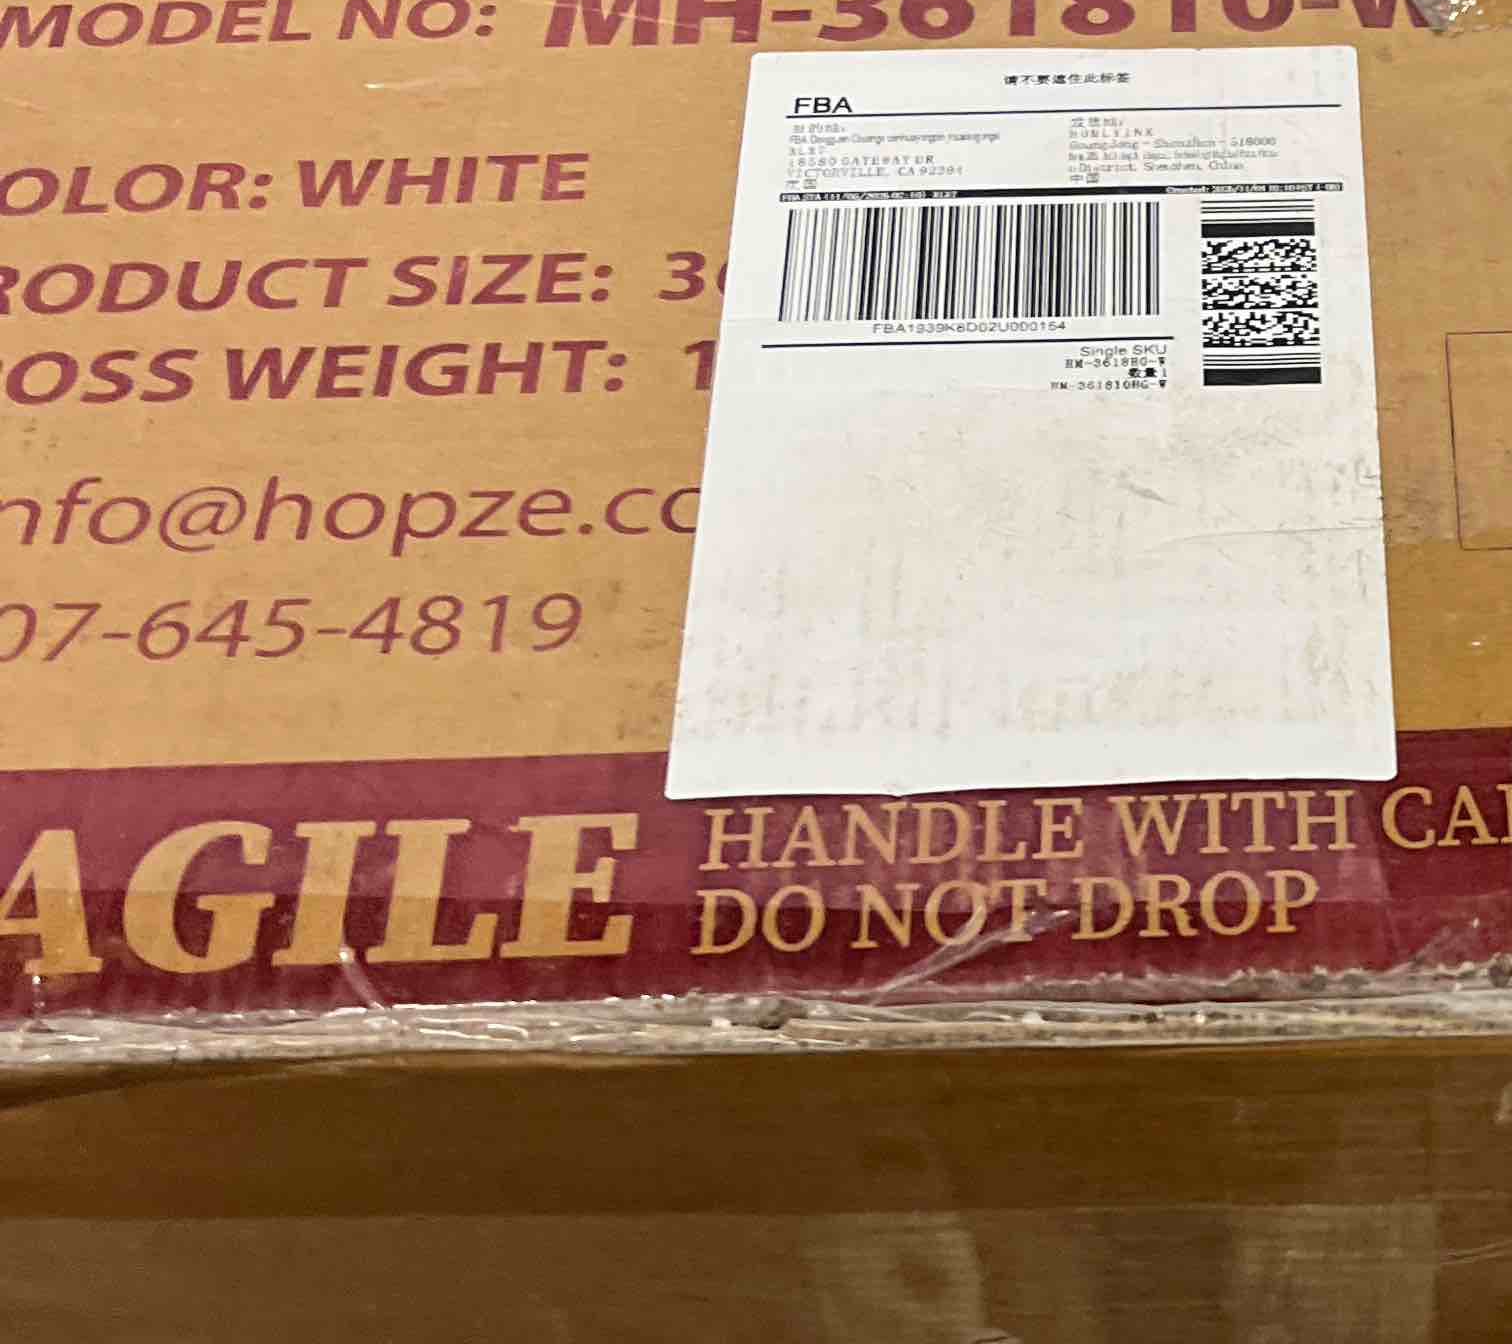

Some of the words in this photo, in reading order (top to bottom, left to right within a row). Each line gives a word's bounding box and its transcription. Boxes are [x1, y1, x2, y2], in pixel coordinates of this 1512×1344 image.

[0, 0, 311, 49] MODEL
[794, 96, 853, 114] FBA
[0, 162, 272, 216] OLOR:
[298, 152, 590, 208] WHITE
[386, 252, 613, 306] SIZE:
[658, 251, 728, 301] 3
[224, 339, 628, 401] WEIGHT:
[1080, 345, 1128, 358] Single
[1132, 345, 1167, 356] SKU
[700, 797, 1084, 872] HANDLE
[1108, 789, 1355, 857] WITH
[0, 812, 640, 978] AGILE
[690, 886, 826, 957] DO
[851, 878, 1052, 949] NOT
[1071, 869, 1321, 942] DROP
